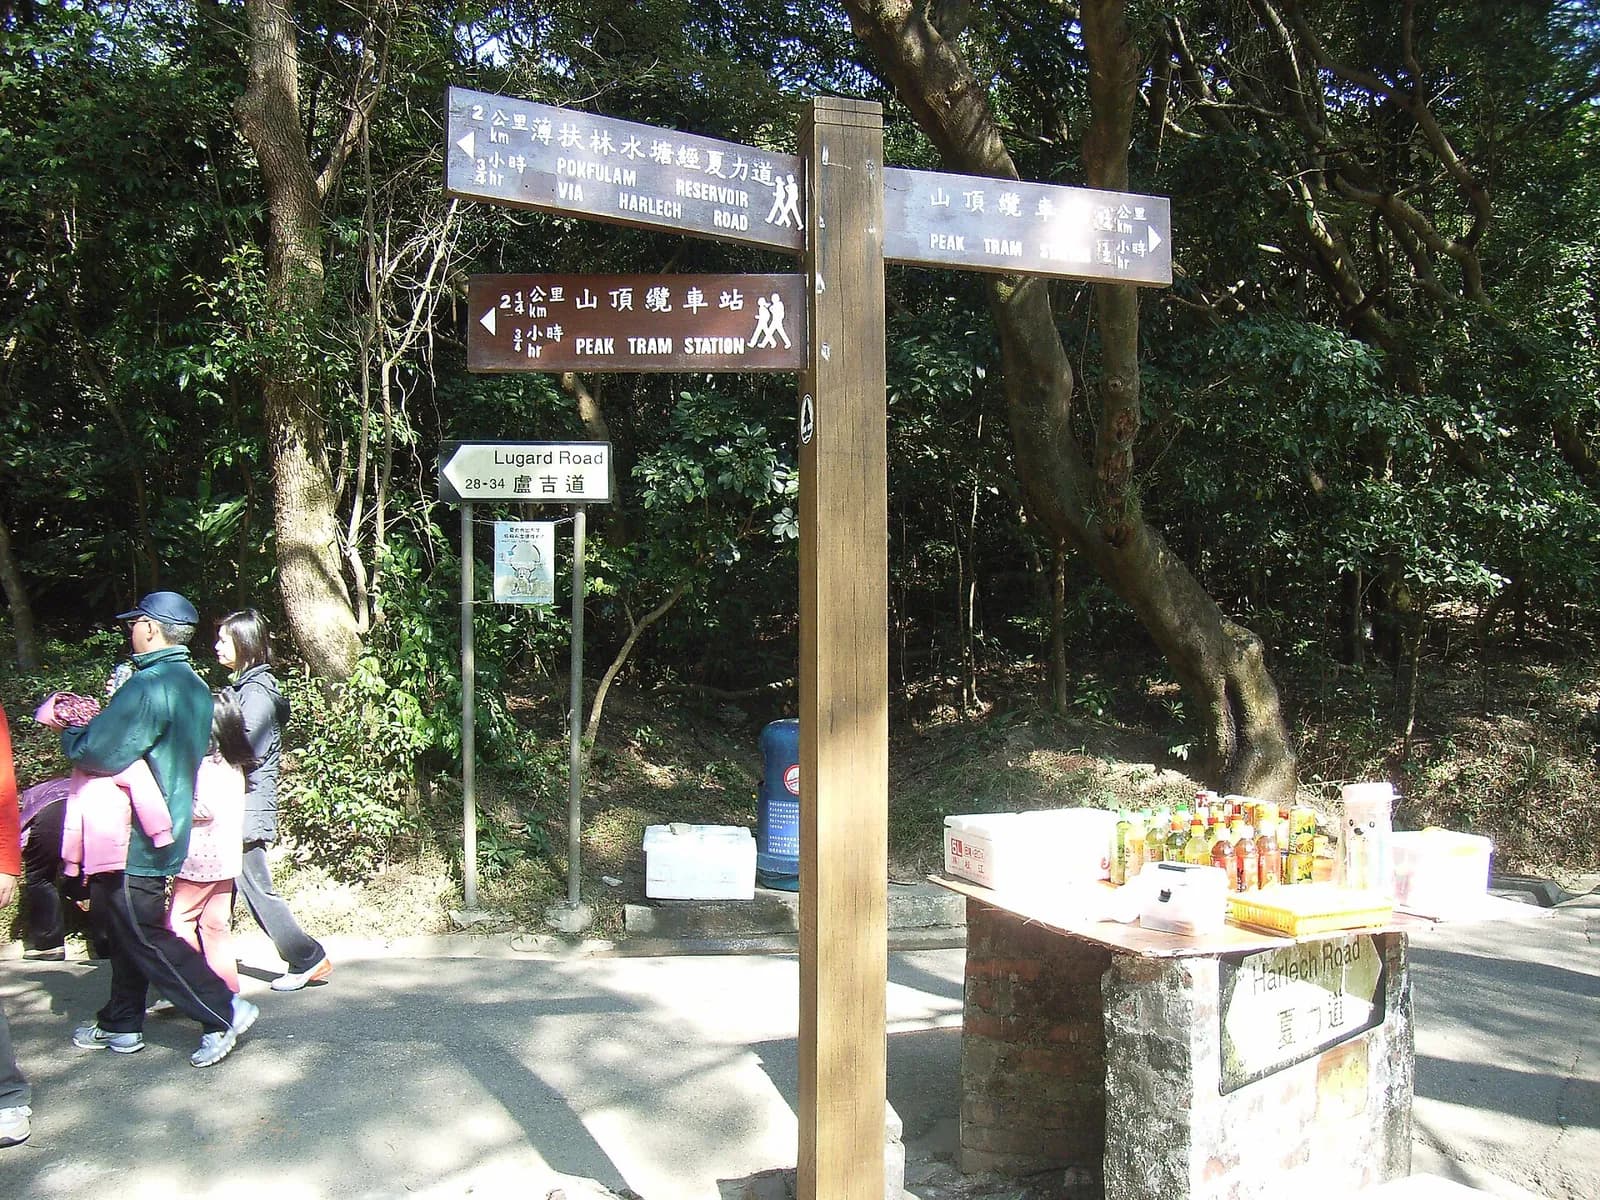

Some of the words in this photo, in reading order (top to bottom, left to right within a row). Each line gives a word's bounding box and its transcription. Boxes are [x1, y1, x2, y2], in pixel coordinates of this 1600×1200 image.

[490, 109, 529, 131] 公里
[490, 126, 509, 145] km
[530, 117, 776, 188] 薄扶林水塘經夏力道
[488, 151, 527, 174] 小時
[489, 170, 505, 187] hr
[556, 157, 637, 188] POKFULAM
[675, 178, 749, 209] RESERVOIR
[557, 181, 585, 202] VIA
[618, 191, 683, 220] HARLECH
[713, 209, 748, 232] ROAD
[930, 187, 1078, 222] 山頂纜車
[1116, 203, 1147, 221] 公里
[1117, 218, 1133, 234] km
[929, 233, 966, 252] PEAK
[983, 237, 1024, 257] TRAM
[1115, 239, 1147, 258] 小時
[1117, 255, 1130, 270] hr
[529, 285, 566, 303] 公里
[575, 286, 744, 315] 山頂纜車站
[529, 302, 547, 319] km
[526, 322, 564, 343] 小時
[527, 343, 543, 359] hr
[575, 337, 615, 355] PEAK
[627, 337, 673, 355] TRAM
[684, 337, 745, 355] STATION
[494, 450, 553, 468] Lugard
[559, 450, 604, 465] Road
[465, 478, 506, 490] 28-34
[513, 474, 585, 494] 盧吉道
[1252, 952, 1318, 995] Harlech
[1322, 939, 1361, 973] Road
